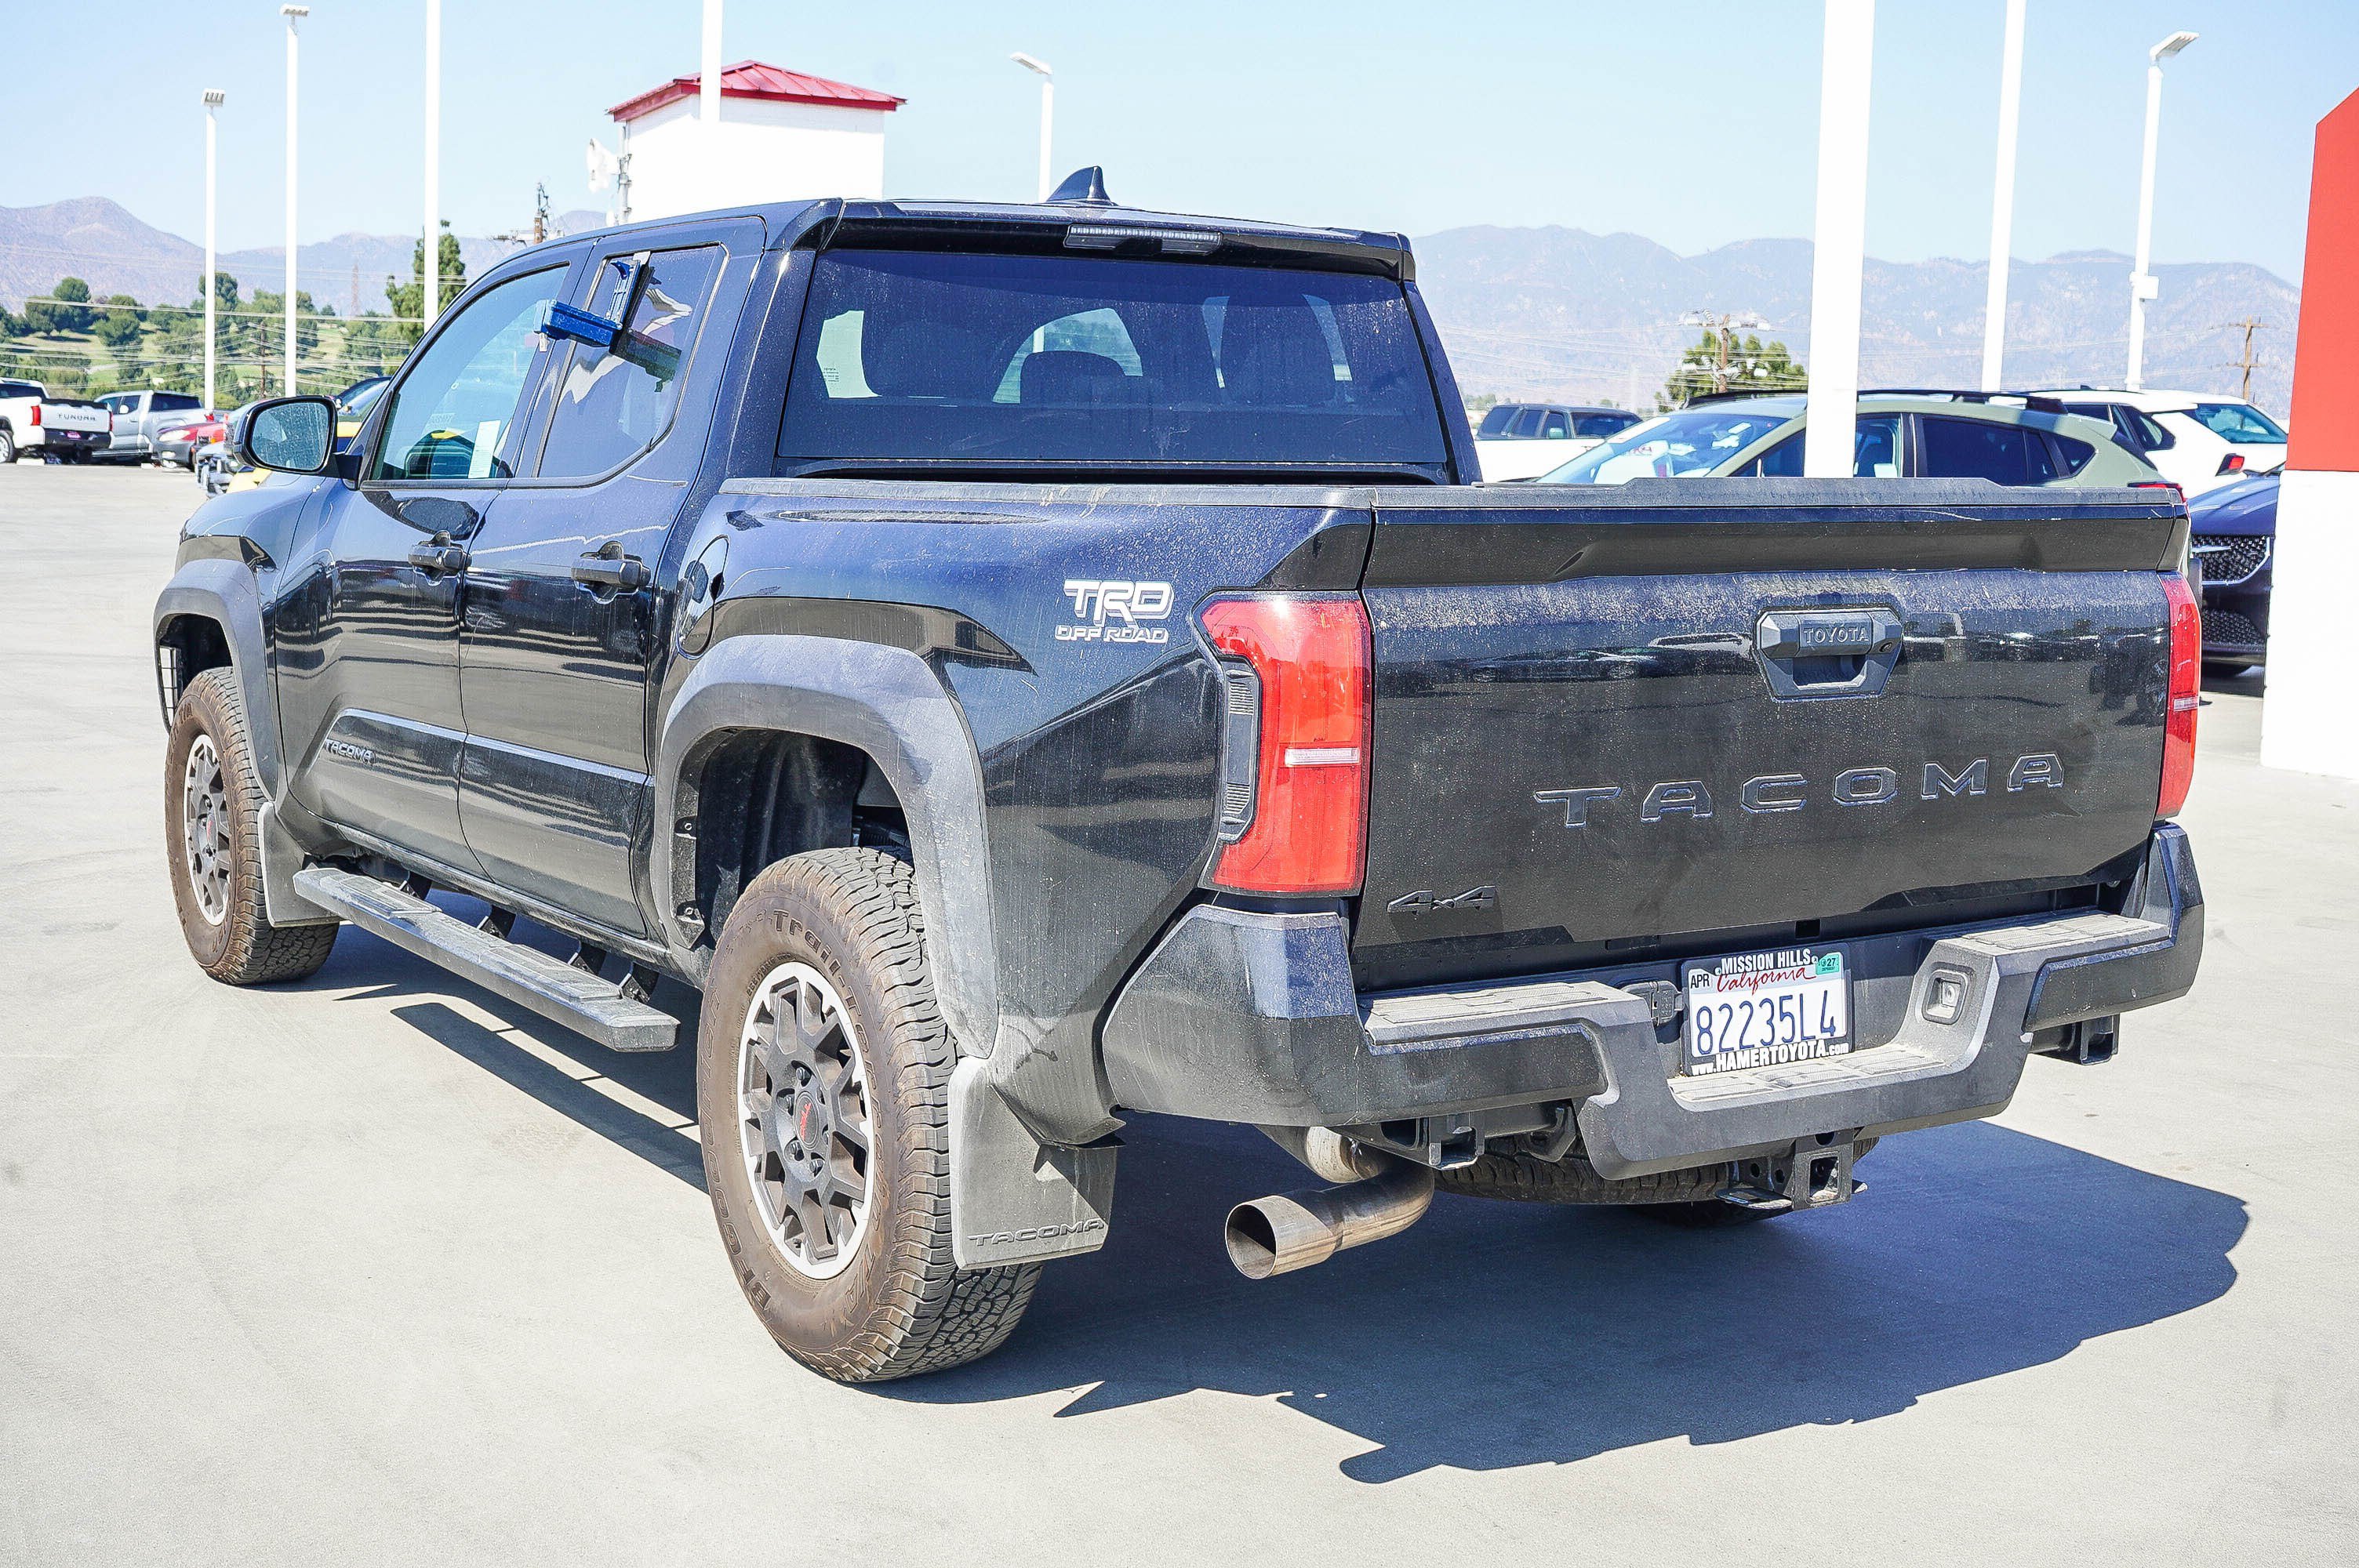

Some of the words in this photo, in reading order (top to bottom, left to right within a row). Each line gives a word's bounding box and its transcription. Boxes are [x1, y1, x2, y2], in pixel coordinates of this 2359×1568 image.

[1063, 579, 1174, 629] TRD
[1055, 624, 1101, 641] OFF
[1103, 626, 1169, 644] ROAD
[1804, 626, 1870, 644] TOYOTA
[324, 739, 376, 765] TACOMA
[1534, 752, 2064, 827] TACOMA
[1721, 955, 1775, 974] MISSION
[1777, 948, 1811, 967] HILLS
[1826, 957, 1837, 967] 27
[1690, 973, 1710, 989] APR
[1717, 967, 1817, 996] California
[1696, 990, 1836, 1054] 82235L4
[967, 1217, 1105, 1247] TACOMA
